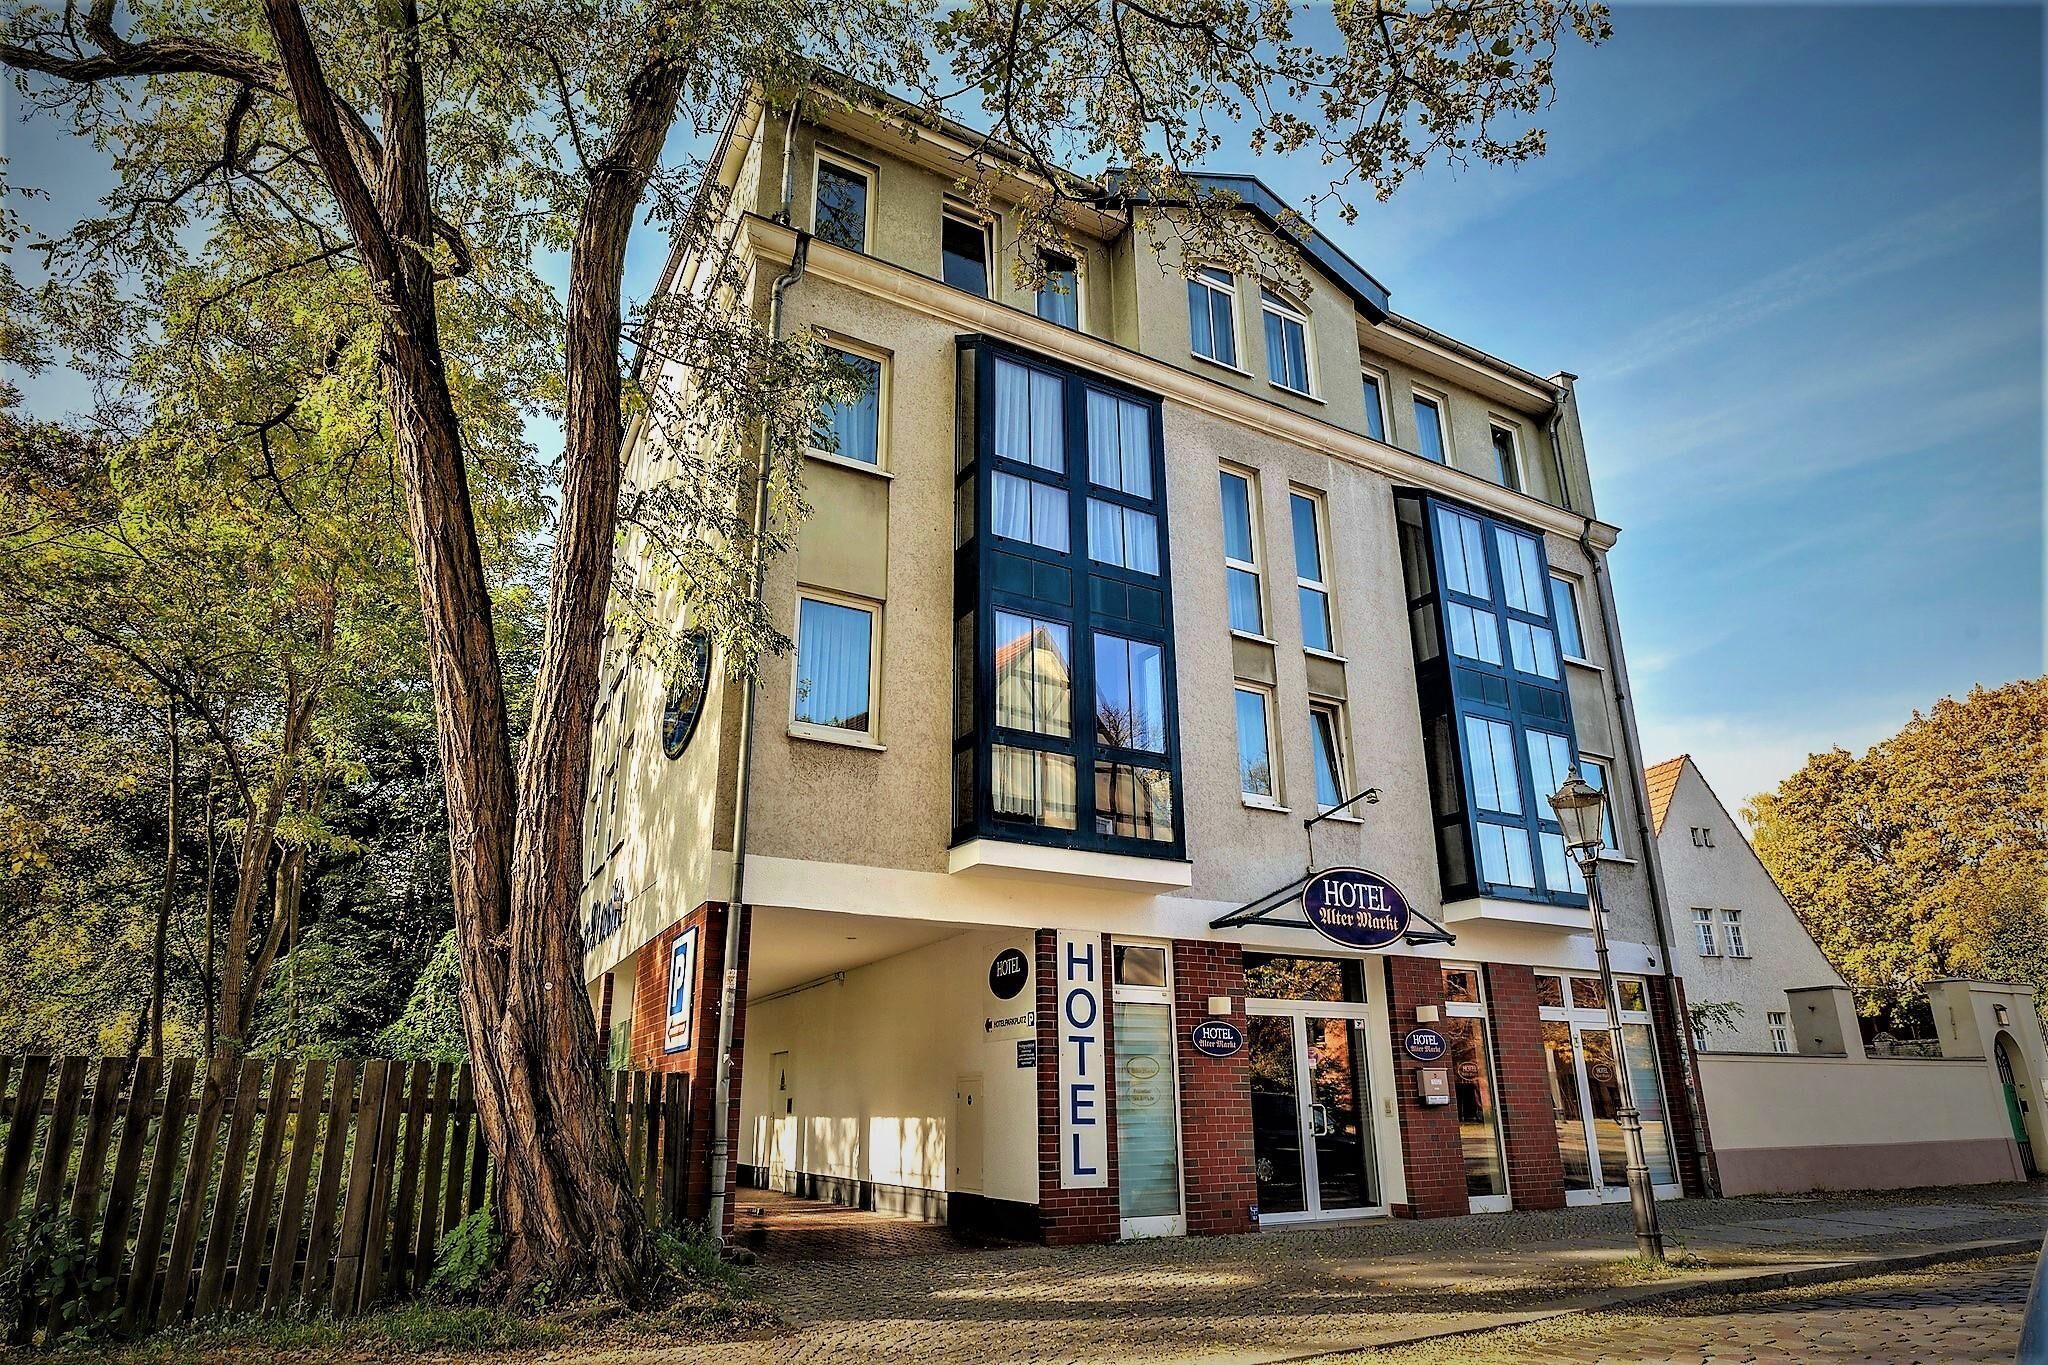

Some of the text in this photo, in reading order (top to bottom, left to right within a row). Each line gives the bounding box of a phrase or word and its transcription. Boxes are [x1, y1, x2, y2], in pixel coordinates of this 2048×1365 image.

[1322, 879, 1391, 912] HOTEL
[1319, 907, 1399, 931] Alter Markt
[996, 956, 1020, 977] HOTEL
[672, 953, 686, 1008] P
[1198, 1038, 1215, 1048] Alter
[1202, 1027, 1234, 1040] HOTEL
[1412, 1034, 1438, 1046] HOTEL
[1065, 941, 1097, 1176] HOTEL
